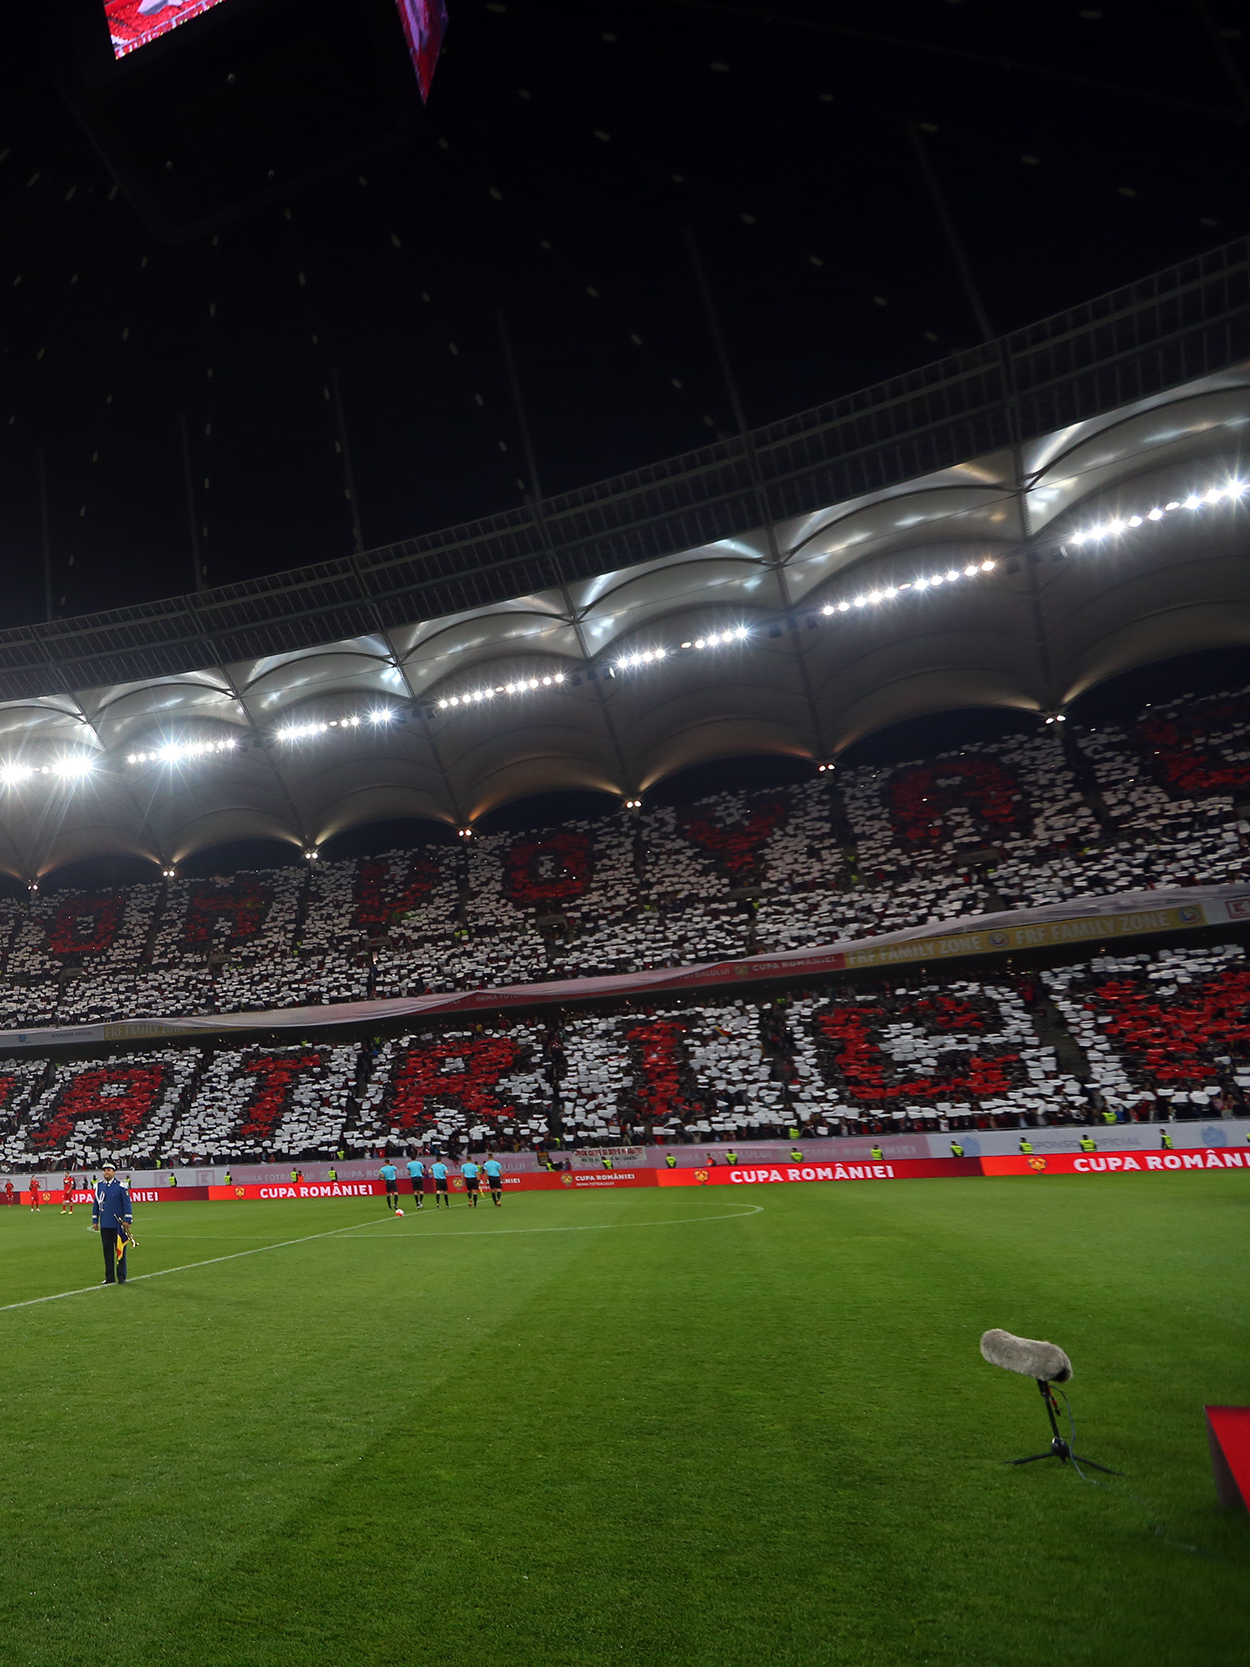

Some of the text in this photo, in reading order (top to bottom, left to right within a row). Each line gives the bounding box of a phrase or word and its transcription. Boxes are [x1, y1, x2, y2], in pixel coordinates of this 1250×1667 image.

[1015, 911, 1171, 946] FRF FAMILY ZONE
[850, 935, 981, 965] FRF FAMILY ZONE
[1073, 1156, 1142, 1172] CUPA
[596, 1173, 636, 1181] ROMÂNIEI
[730, 1163, 895, 1184] CUPA ROMÂNIEI
[260, 1183, 374, 1199] CUPA ROMÂNIEI
